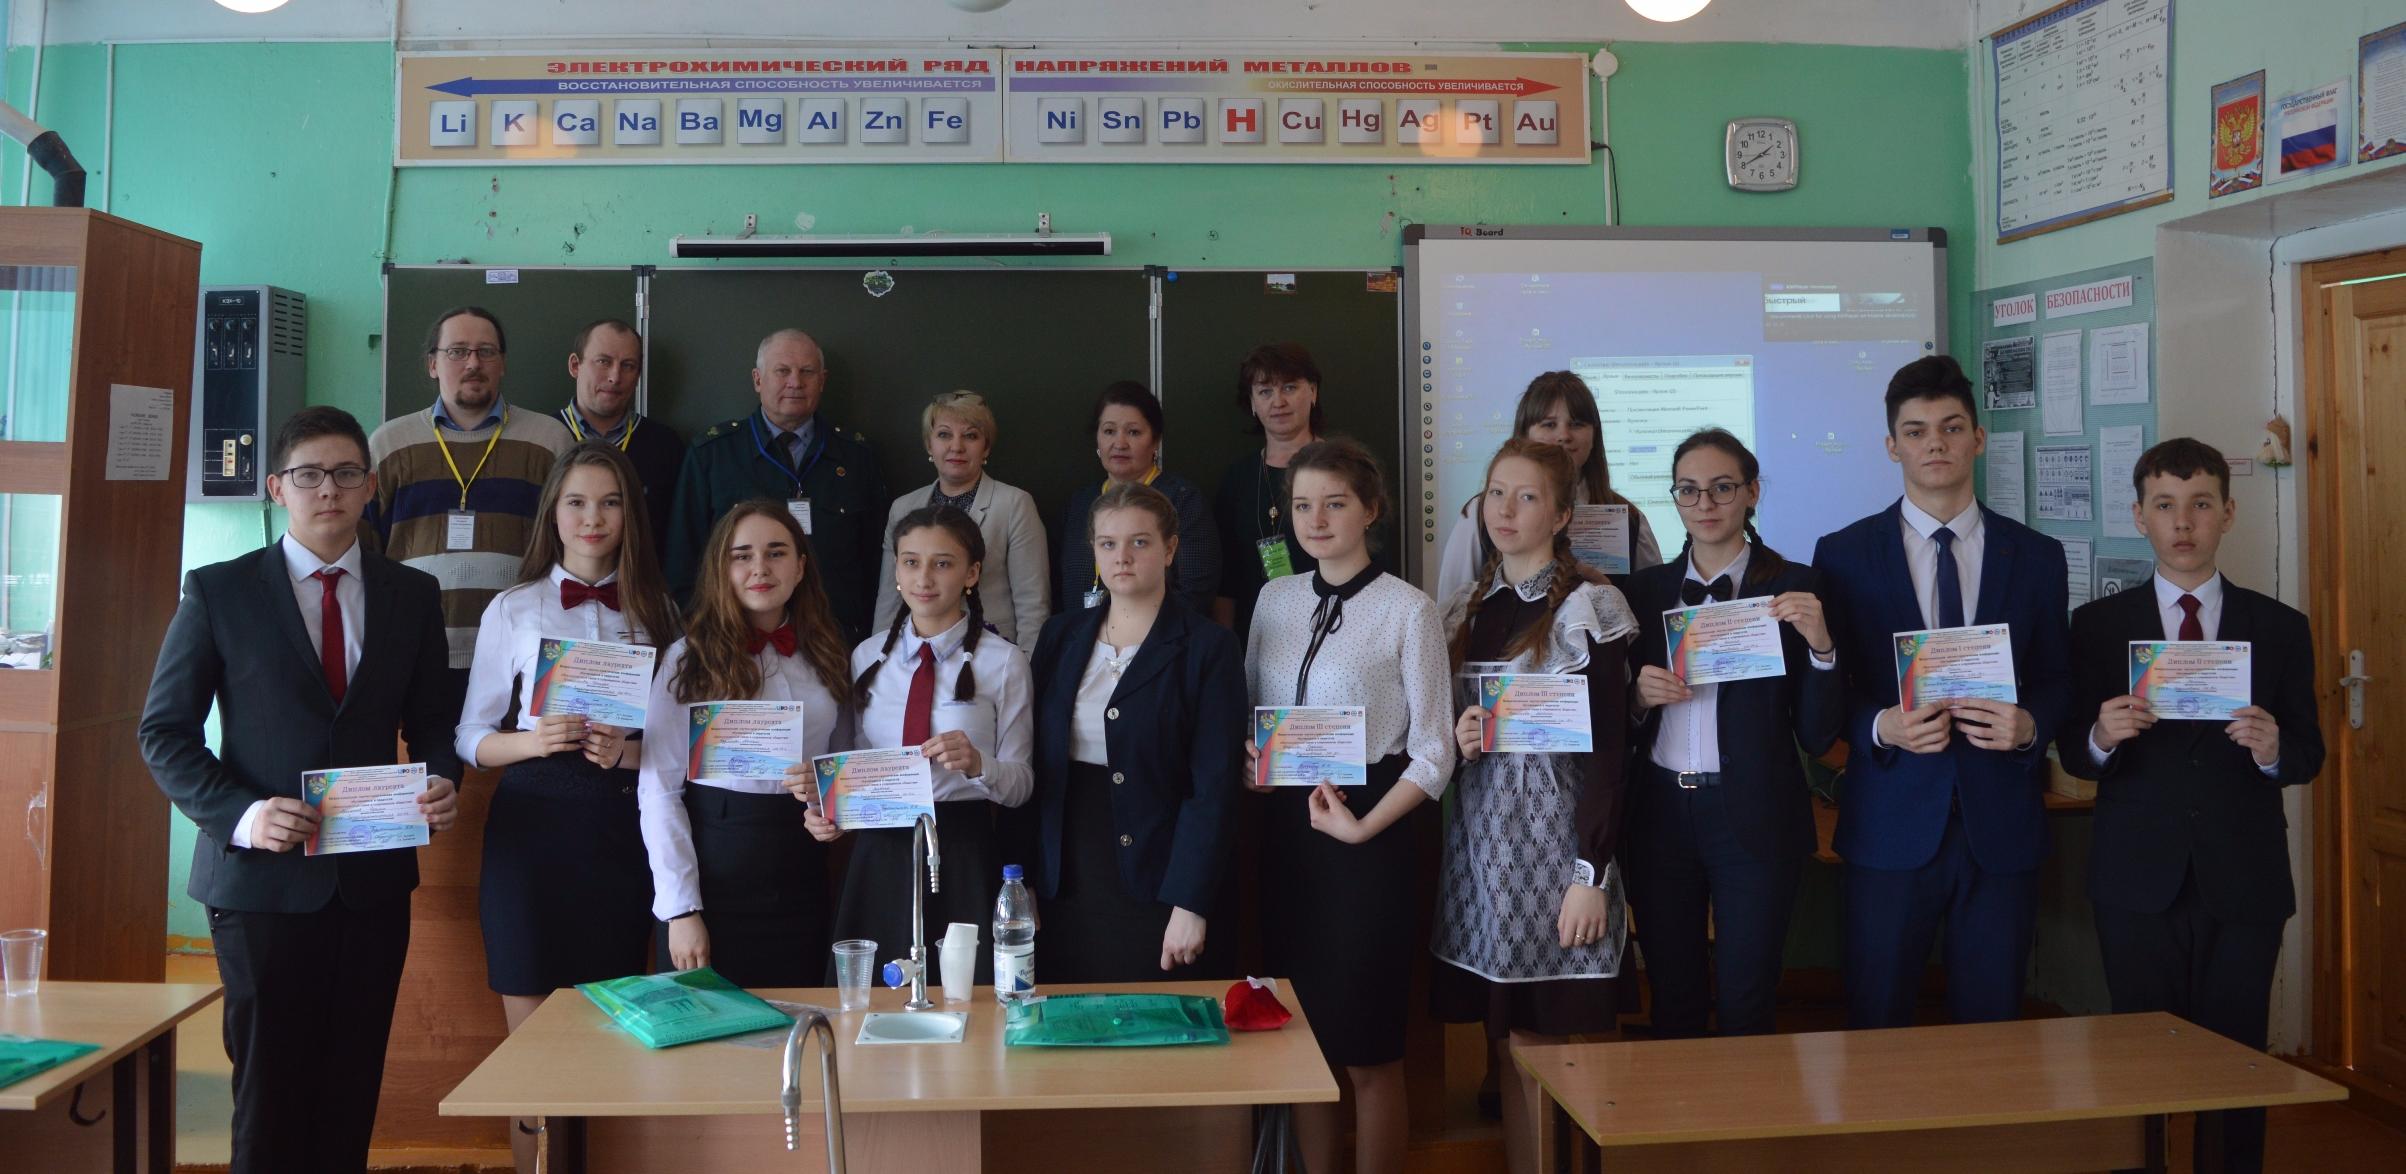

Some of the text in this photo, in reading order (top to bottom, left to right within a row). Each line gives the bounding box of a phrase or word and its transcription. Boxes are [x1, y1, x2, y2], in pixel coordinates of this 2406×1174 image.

[547, 59, 1412, 74] ЭЛЕКТРОХИМИЧЕСКИЙ РЯД НАПРЯЖЕНИЙ МЕТАЛЛОВ
[558, 80, 982, 90] ВОССТАНОВИТЕЛЬНАЯ СПОСОБНОСТЬ УВЕЛИЧИВАЕТСЯ
[1268, 80, 1524, 91] ОКИСЛИТЕЛЬНАЯ СПОСОБНОСТЬ УВЕЛИЧИВАЕТСЯ
[441, 109, 1555, 132] Li K Ca Na Ba Mg Al Zn Fe Ni Sn Pb H Cu Hg Ag Pt Au
[1748, 133, 1755, 141] 11
[1757, 130, 1765, 138] 12
[1776, 141, 1782, 149] 2
[1737, 151, 1743, 159] 9
[1780, 151, 1785, 159] 3
[1759, 172, 1764, 180] 6
[1476, 228, 1504, 236] Board
[1995, 281, 2130, 319] УГОЛОК БЕЗОПАСНОСТИ
